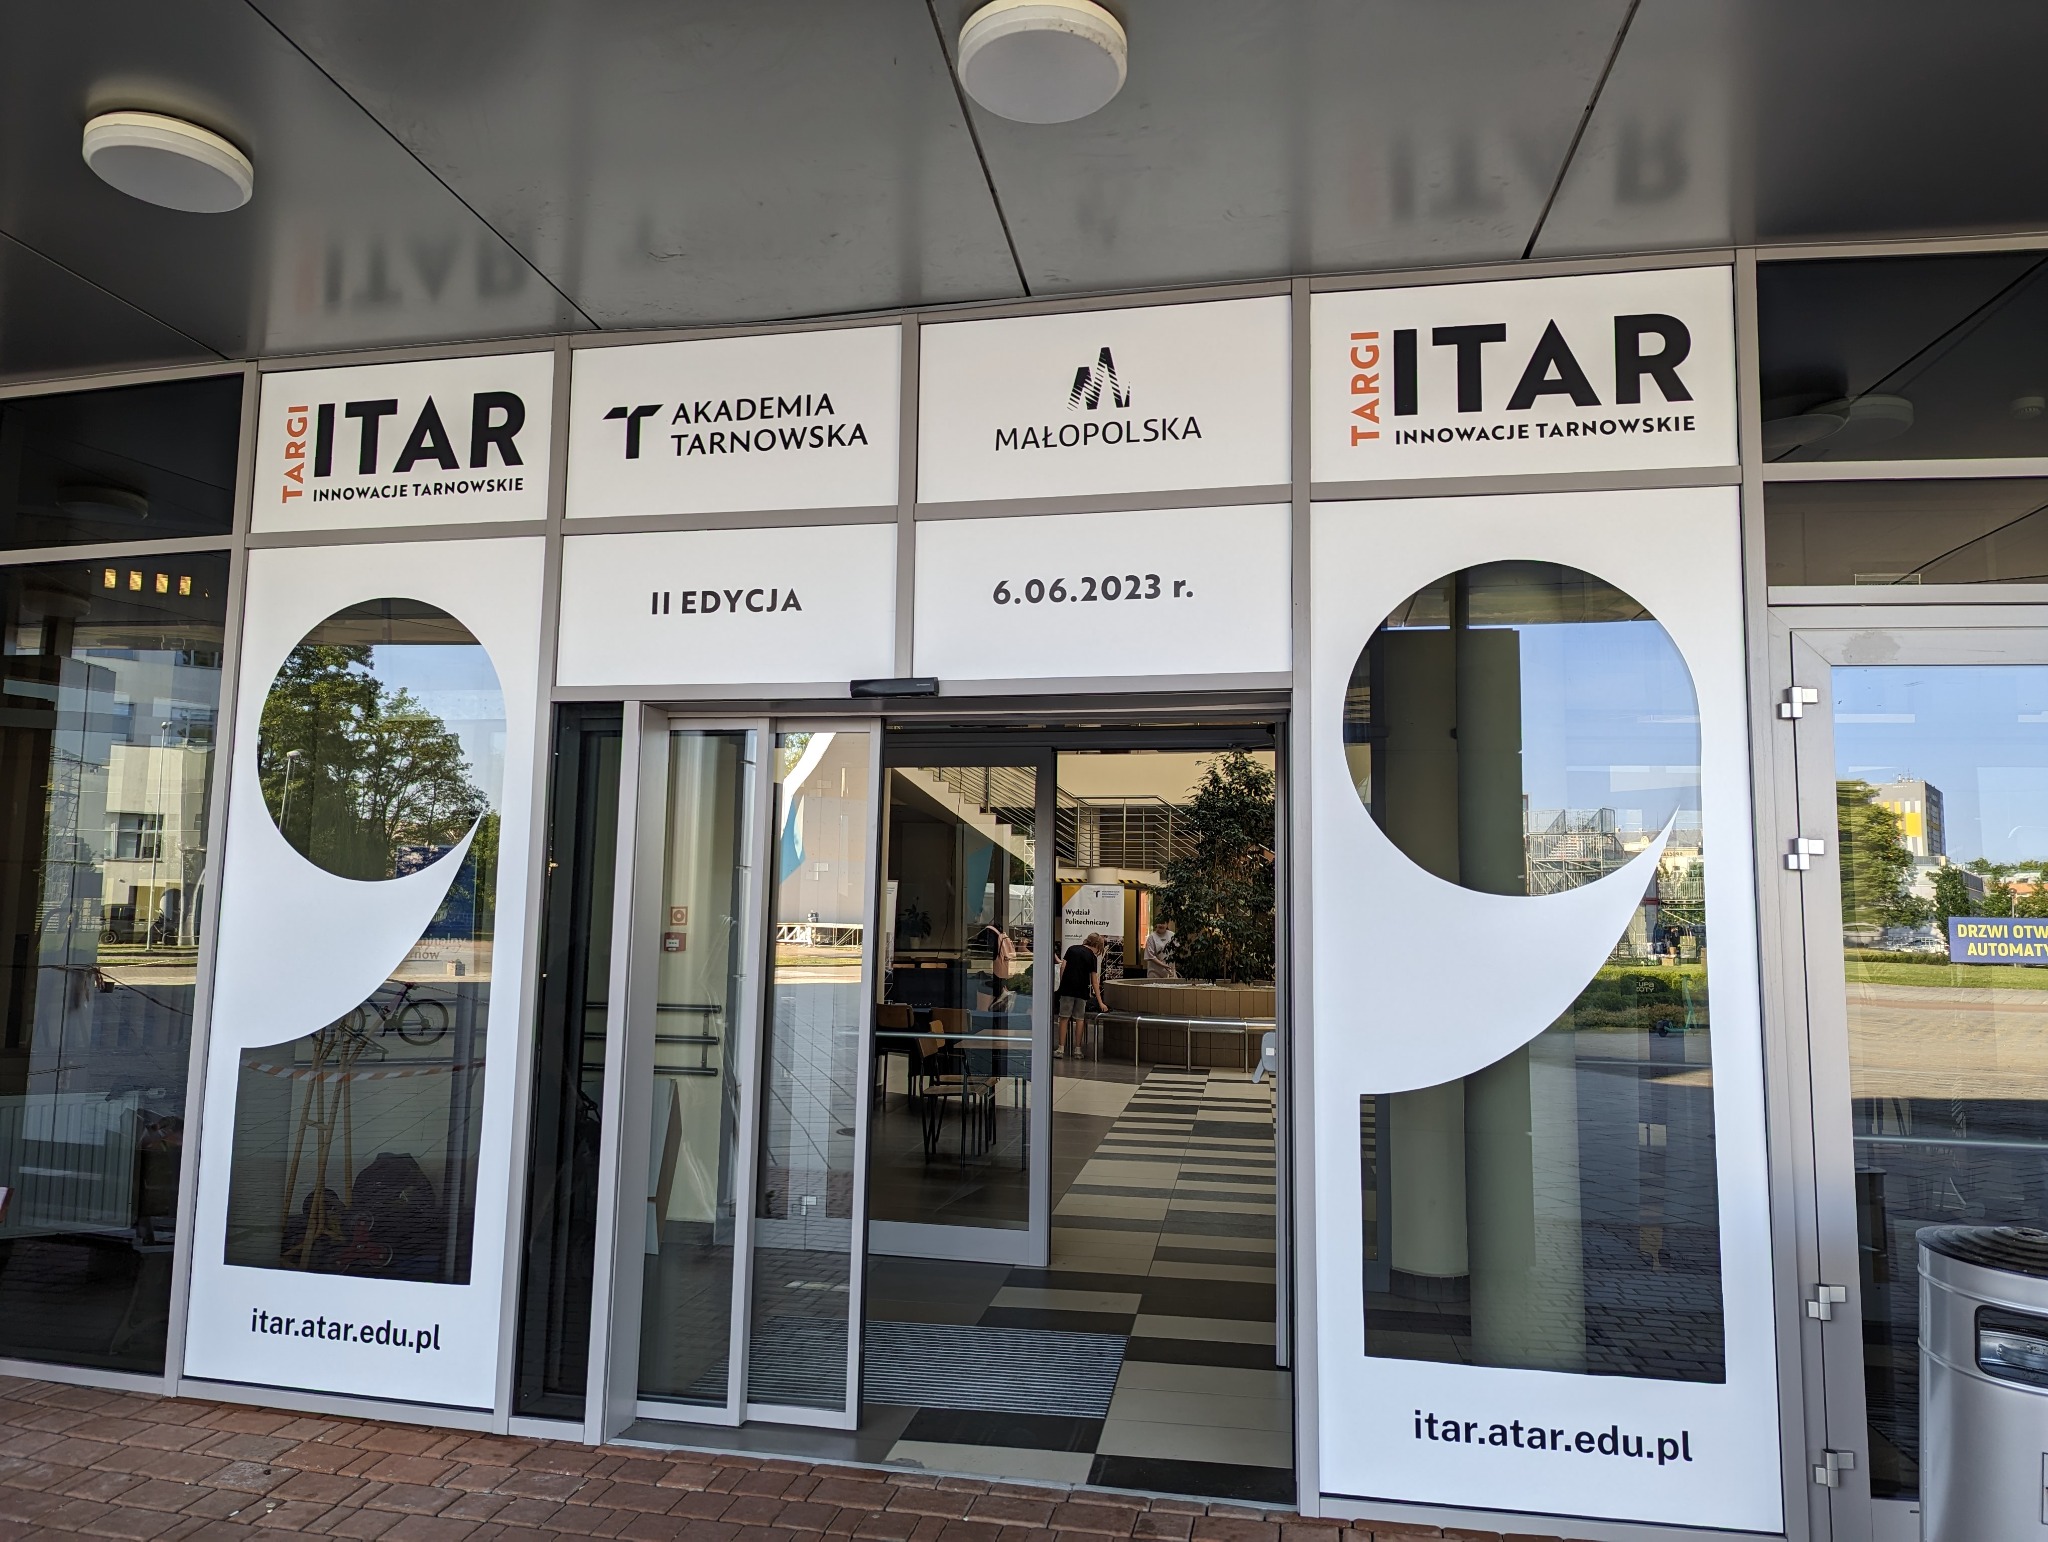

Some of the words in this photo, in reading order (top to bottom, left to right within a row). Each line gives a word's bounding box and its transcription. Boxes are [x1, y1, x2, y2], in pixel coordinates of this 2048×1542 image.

[1393, 313, 1694, 416] ITAR
[1351, 331, 1380, 447] TARGI
[671, 393, 835, 426] AKADEMIA
[314, 392, 526, 477] ITAR
[670, 422, 869, 457] TARNOWSKA
[995, 416, 1203, 452] MAŁOPOLSKA
[1395, 423, 1530, 445] INNOWACJE
[1536, 415, 1695, 439] TARNOWSKIE
[281, 405, 309, 504] TARGI
[313, 484, 408, 502] INNOWACJE
[412, 477, 524, 497] TARNOWSKIE
[651, 591, 670, 615] II
[681, 588, 803, 615] EDYCJA
[993, 573, 1161, 605] 6.06.2023
[1173, 579, 1194, 598] r.
[1065, 909, 1090, 917] Wydział
[1065, 918, 1110, 928] Politechniczny
[1957, 924, 2009, 938] DRZWI
[251, 1307, 441, 1354] itar.atar.edu.pl
[1414, 1409, 1693, 1466] itar.atar.edu.pl
